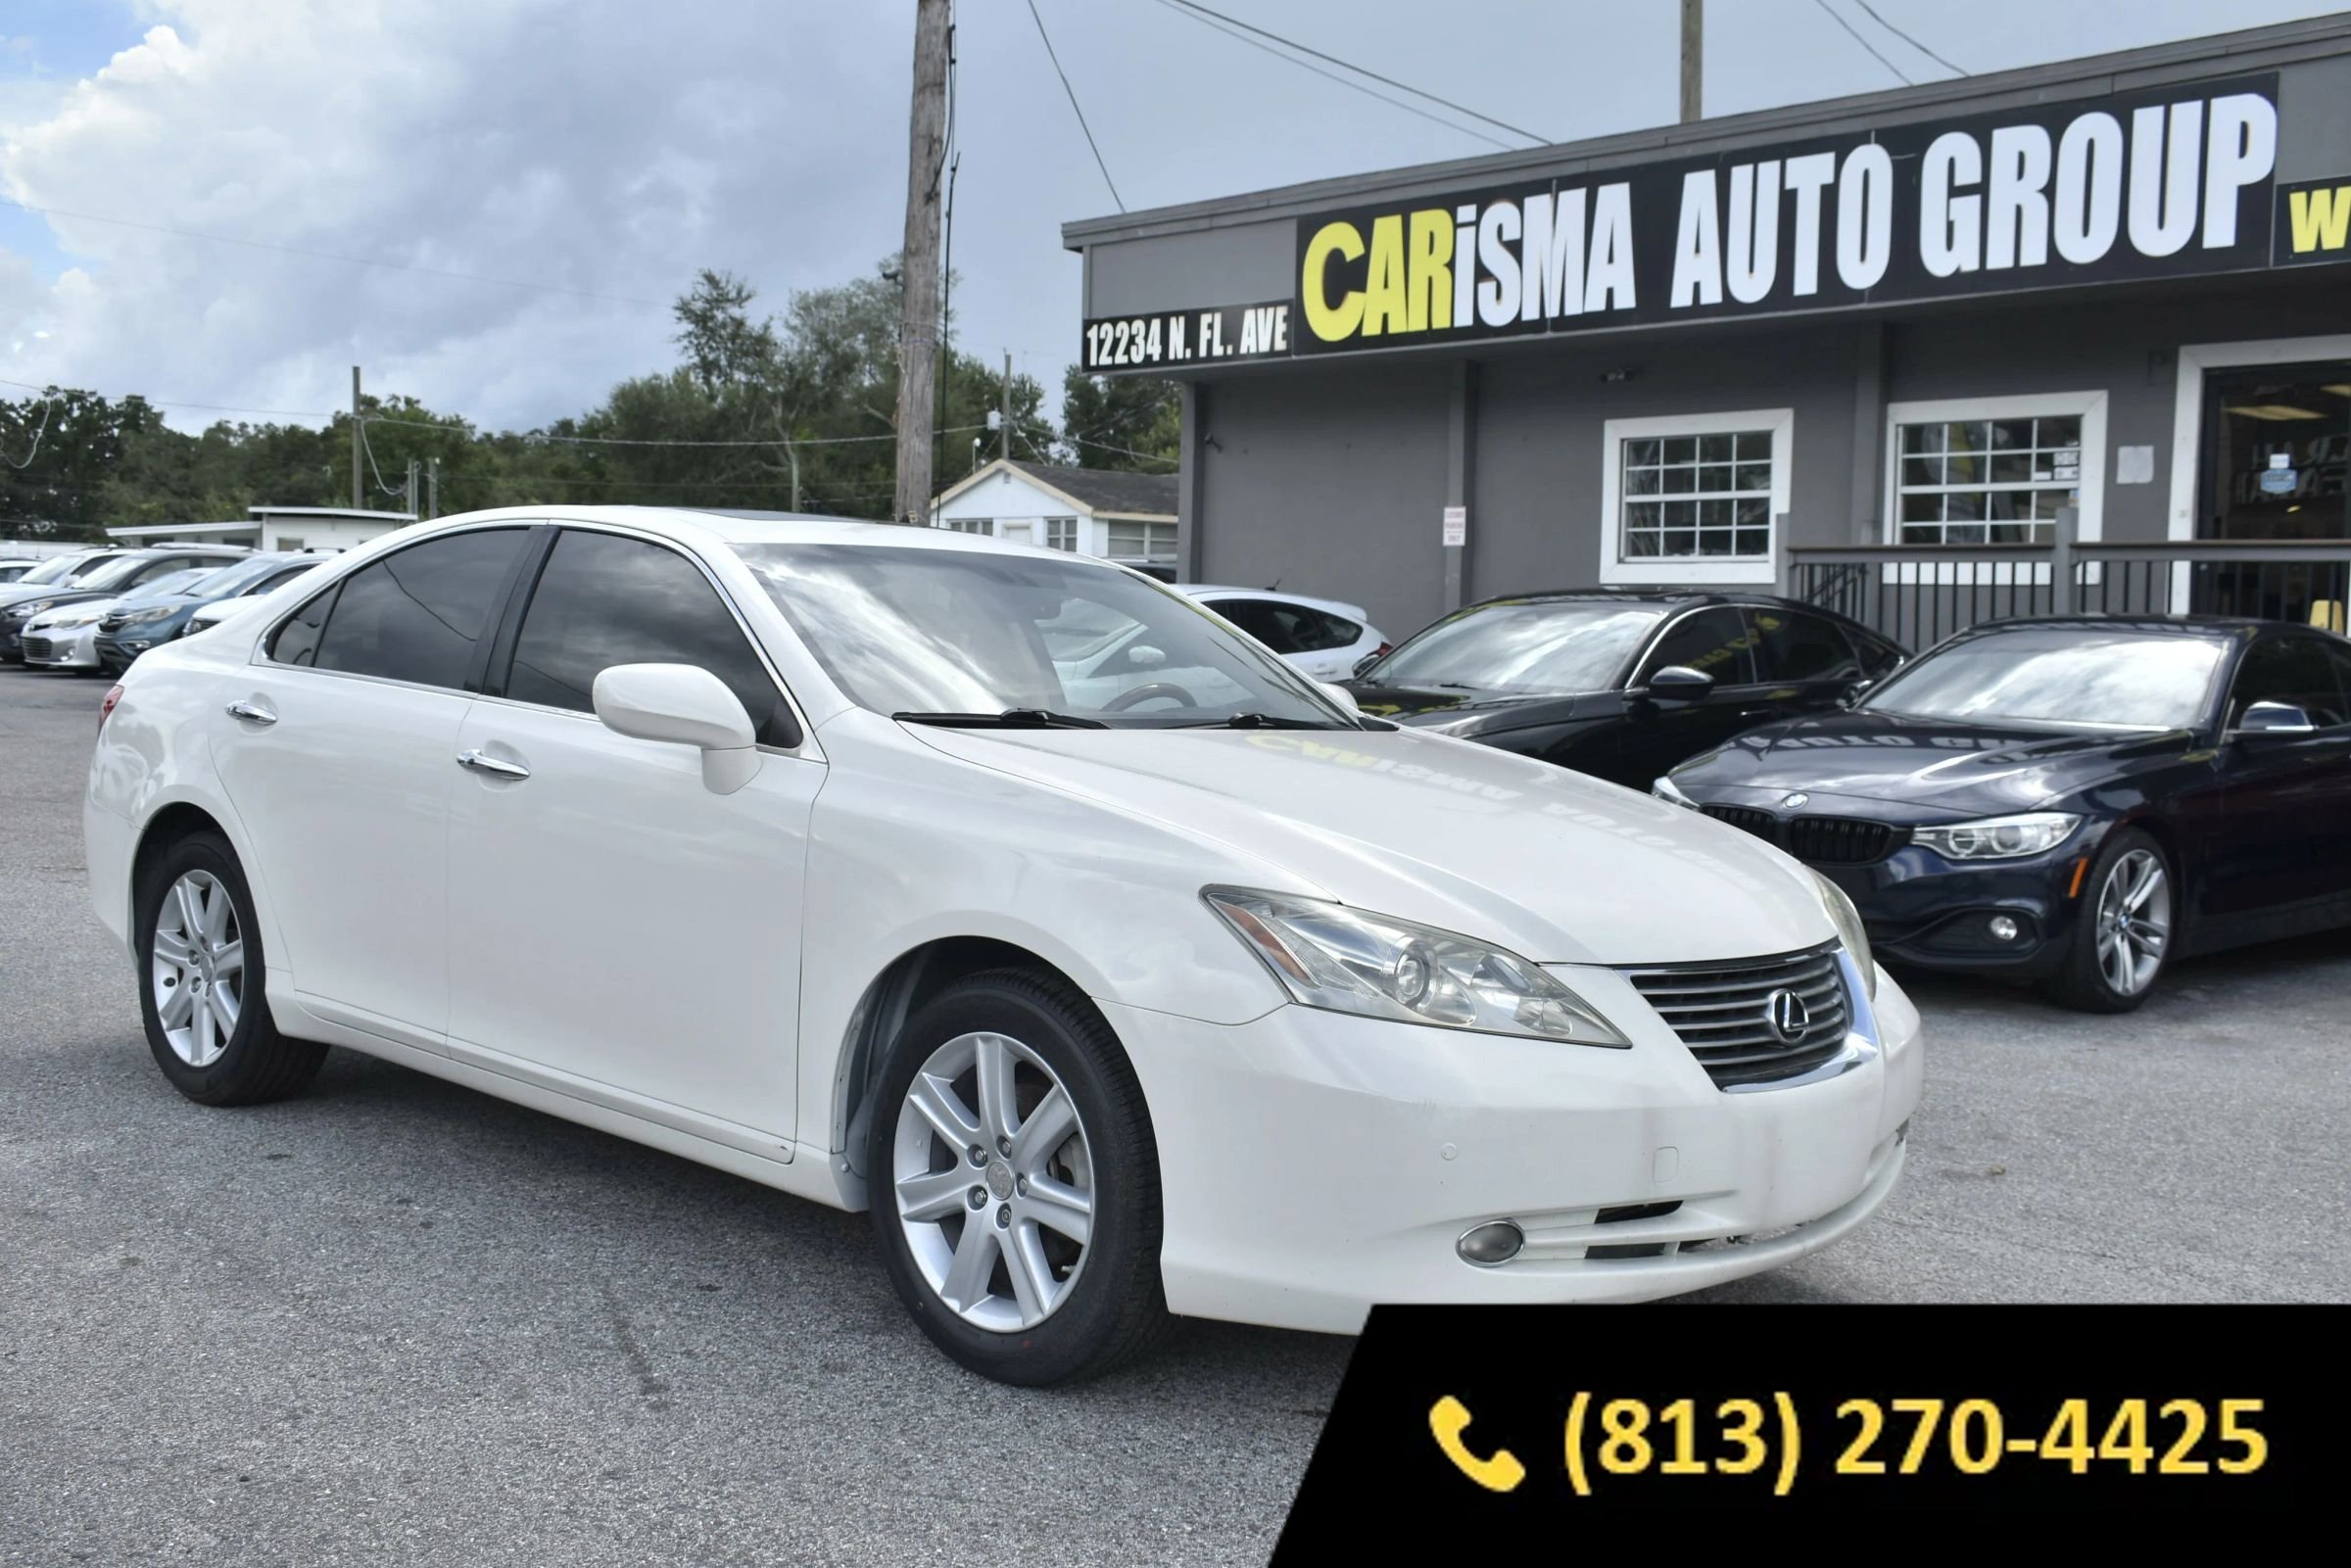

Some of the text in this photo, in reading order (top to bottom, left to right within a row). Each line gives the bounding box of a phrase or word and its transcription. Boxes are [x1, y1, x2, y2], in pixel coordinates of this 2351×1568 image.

[1669, 143, 1893, 309] AUTO
[1919, 93, 2278, 278] GROUP
[1086, 306, 1288, 367] 12234 N. FL. AVE
